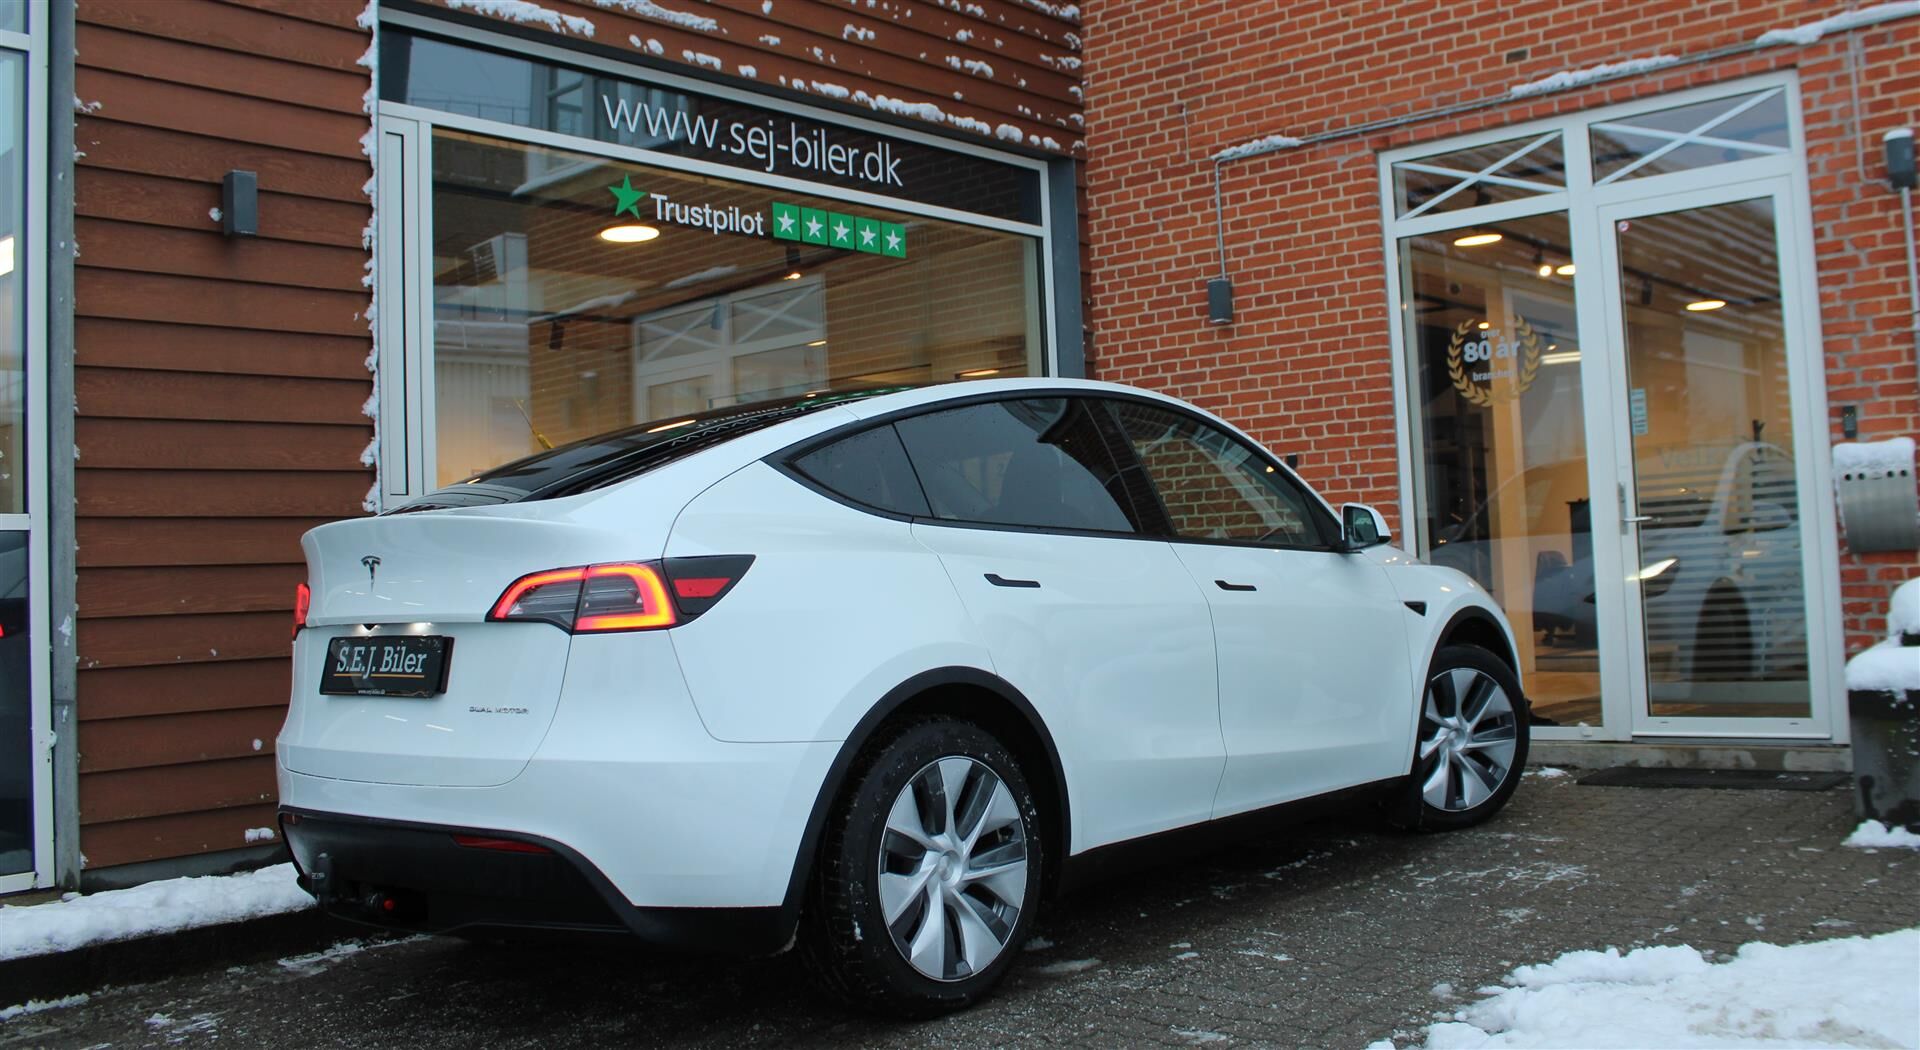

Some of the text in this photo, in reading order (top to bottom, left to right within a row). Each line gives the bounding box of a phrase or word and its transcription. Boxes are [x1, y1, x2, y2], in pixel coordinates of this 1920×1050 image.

[602, 94, 903, 187] www.sej-biler.dk
[650, 193, 764, 236] Trustpilot
[1463, 335, 1520, 362] 80 år
[336, 646, 427, 679] S.E.J. Biler
